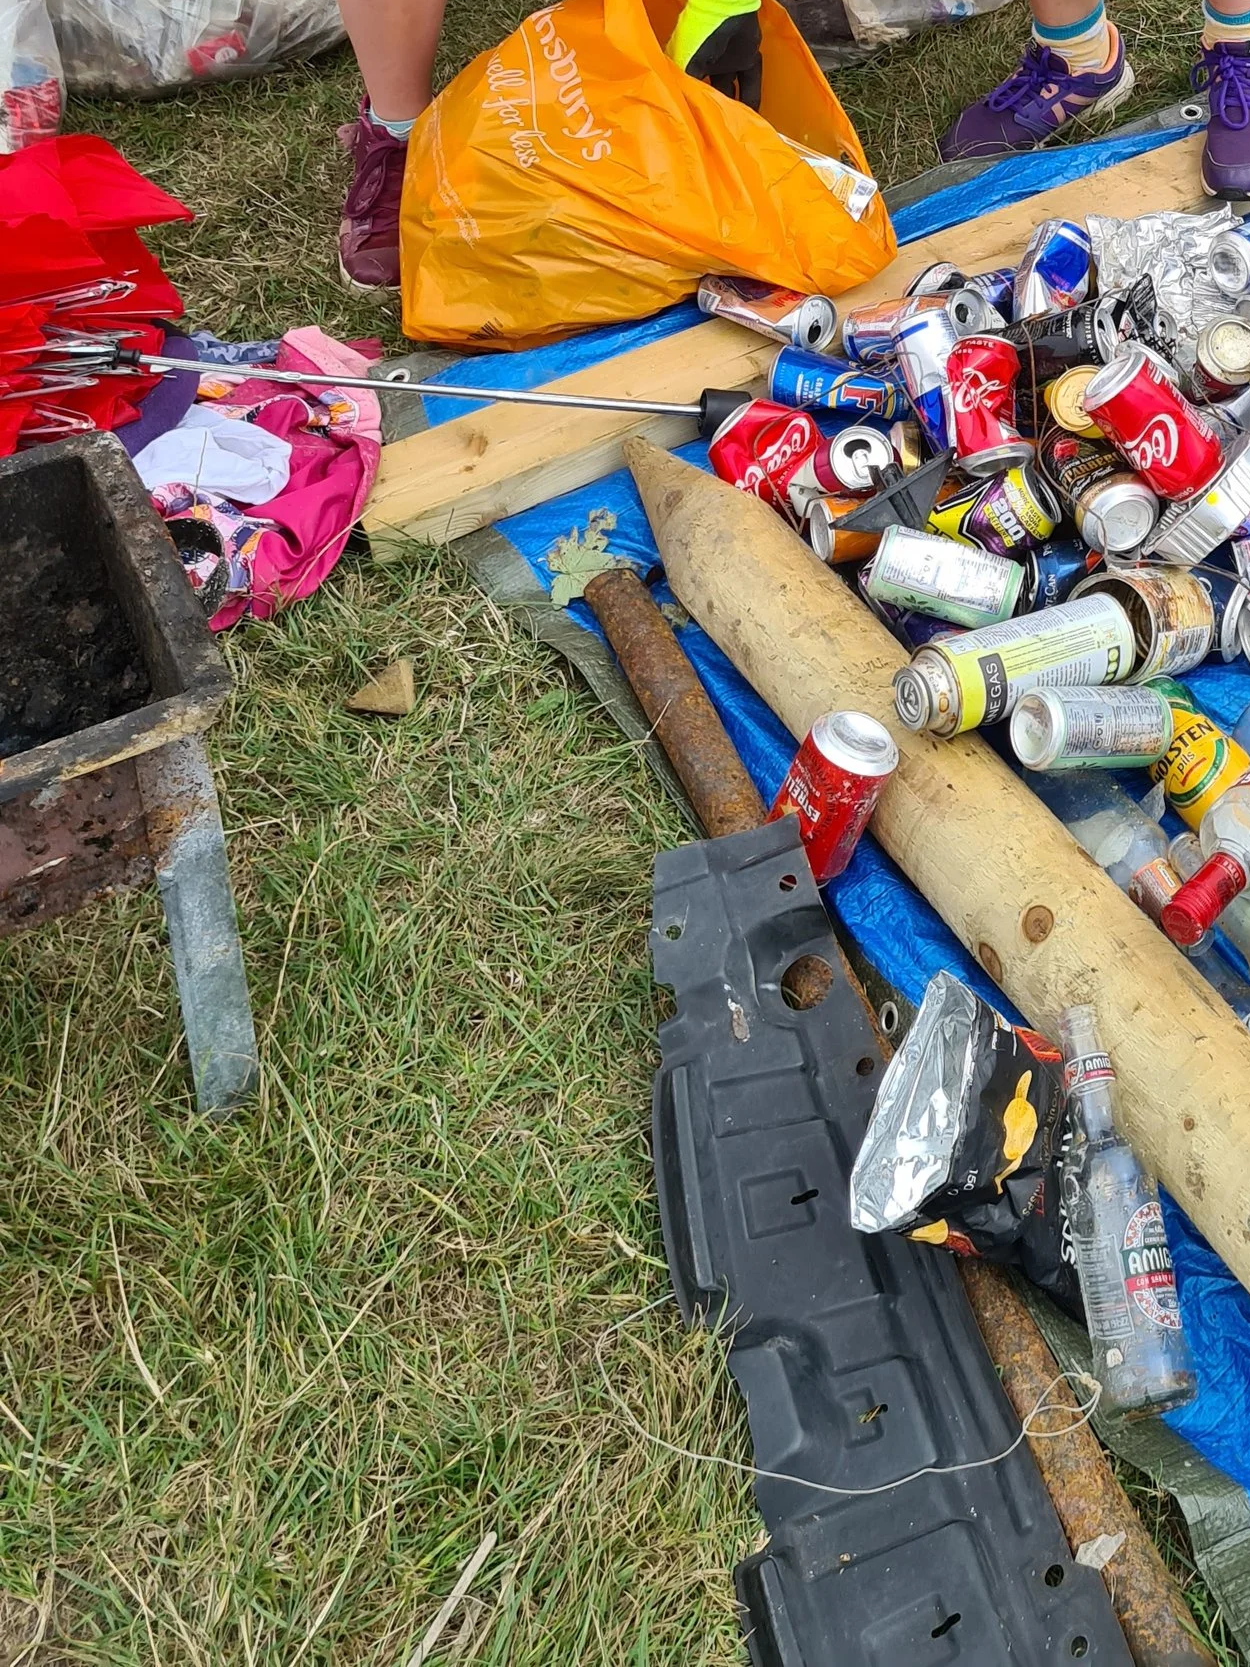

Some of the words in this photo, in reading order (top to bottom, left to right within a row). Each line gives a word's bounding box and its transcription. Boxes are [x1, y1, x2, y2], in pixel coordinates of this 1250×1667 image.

[481, 96, 531, 127] for
[508, 130, 547, 169] less
[989, 496, 1026, 543] 200
[985, 662, 1001, 698] GAS
[1153, 719, 1215, 784] HOLSTEN
[1176, 750, 1196, 775] pils
[963, 1169, 979, 1191] 150
